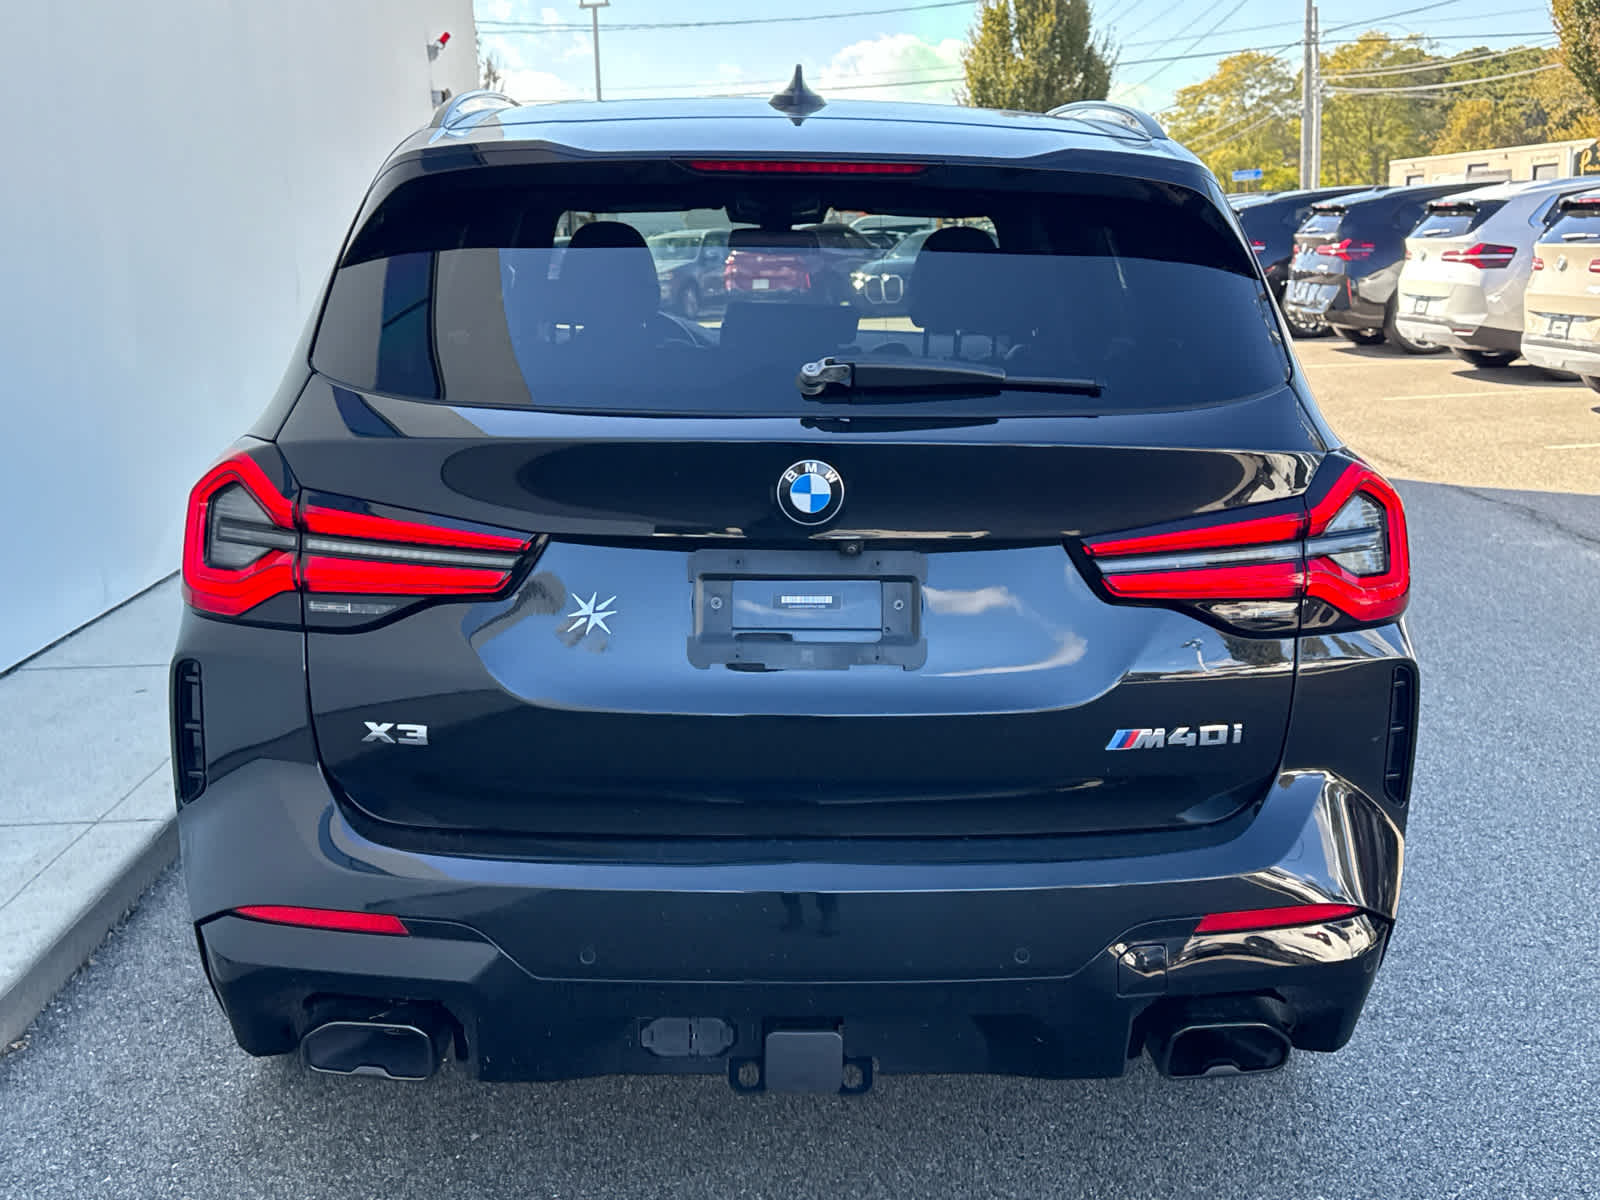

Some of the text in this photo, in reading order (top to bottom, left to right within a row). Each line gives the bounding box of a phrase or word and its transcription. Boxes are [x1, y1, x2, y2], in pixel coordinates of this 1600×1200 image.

[785, 463, 838, 483] BMW
[361, 721, 428, 745] X3
[1108, 723, 1242, 750] M40i
